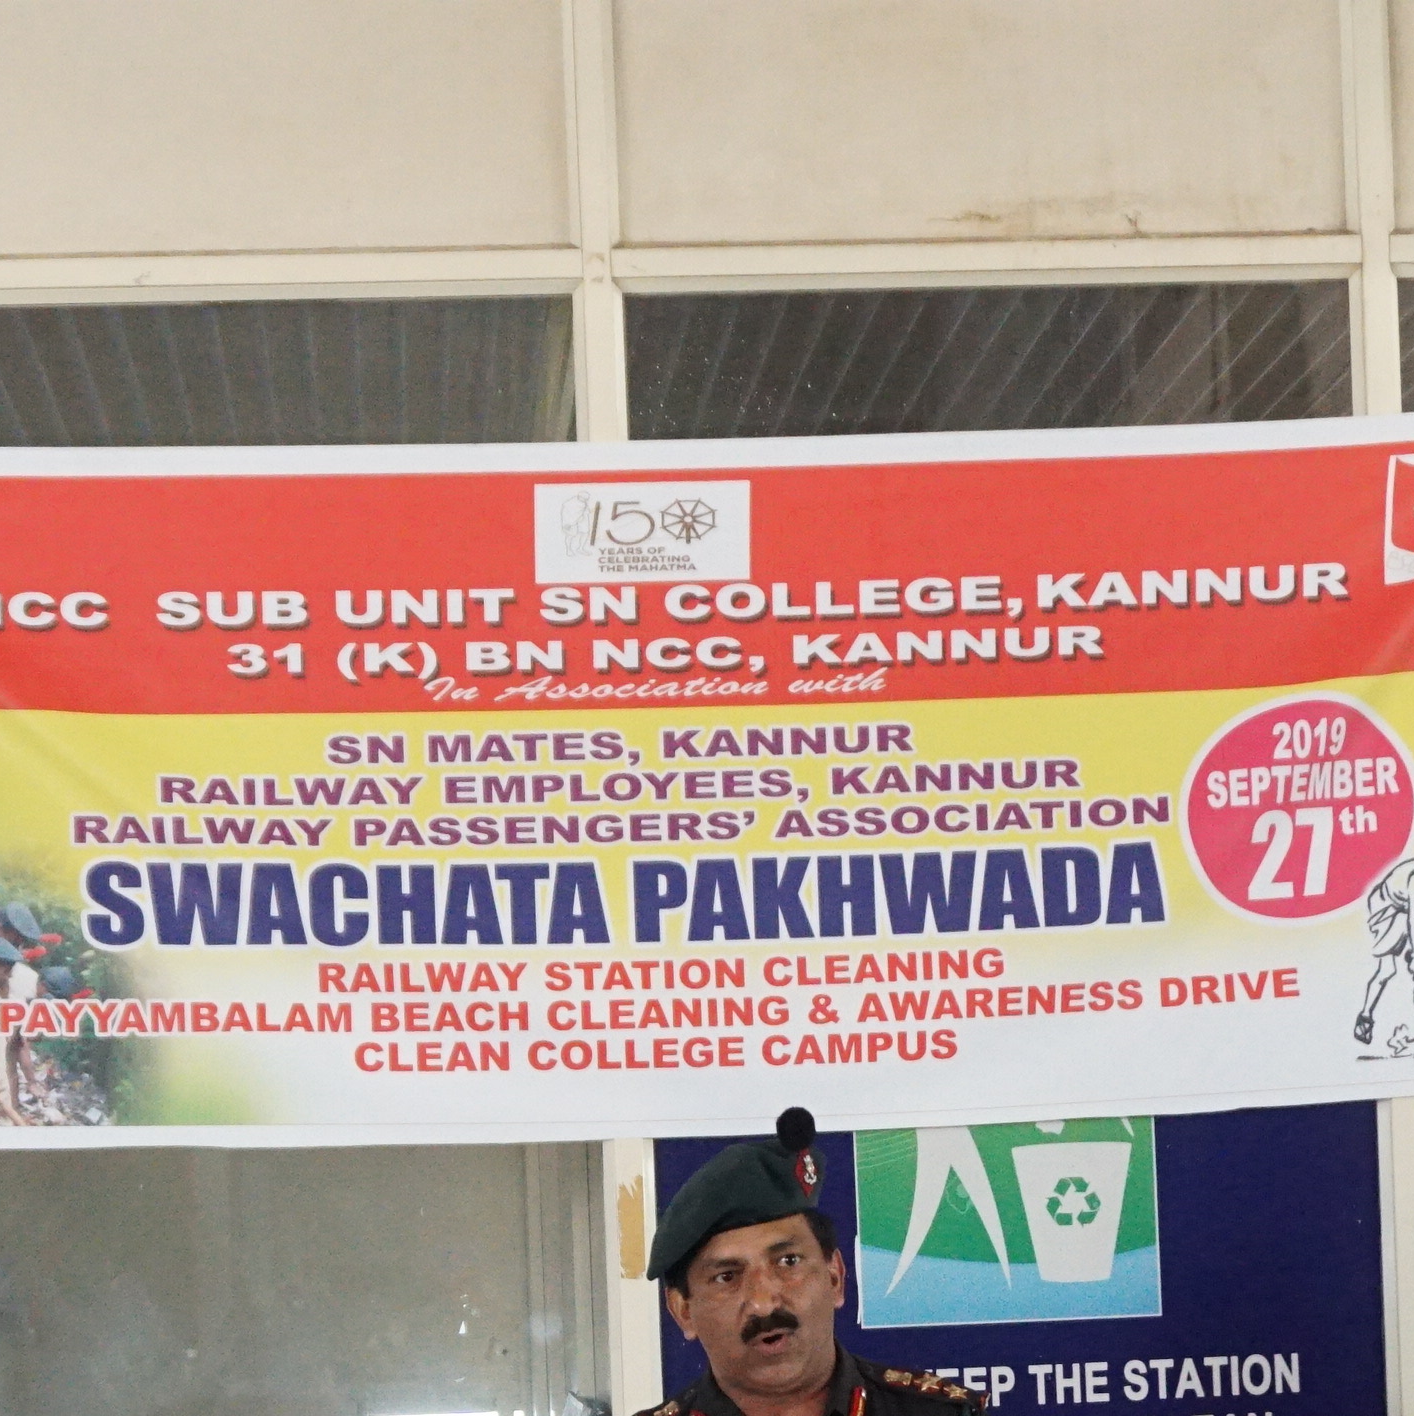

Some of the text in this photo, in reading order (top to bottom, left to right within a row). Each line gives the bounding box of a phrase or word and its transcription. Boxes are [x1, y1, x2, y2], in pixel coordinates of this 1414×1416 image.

[598, 546, 666, 555] YEARS OF
[598, 555, 691, 564] CELEBRATING
[599, 563, 697, 573] THE MAHATMA
[156, 590, 308, 628] SUB
[335, 587, 515, 626] UNIT
[539, 585, 638, 623] SN
[227, 625, 1105, 681] 31 (K) BN NCC, KANNUR
[423, 667, 888, 702] In Association with
[327, 724, 913, 766] SN MATES, KANNUR
[1272, 716, 1348, 760] 2019
[159, 759, 1080, 806] RAILWAY EMPLOYEES, KANNUR
[1206, 756, 1400, 809] SEPTEMBER
[73, 815, 333, 846] RAILWAY
[774, 796, 1170, 840] ASSOCIATION
[86, 841, 1166, 947] SWACHATA PAKHWADA
[318, 947, 1005, 994] RAILWAY STATION CLEANING
[371, 1000, 529, 1033] BEACH
[547, 994, 790, 1031] CLEANING
[808, 993, 840, 1025] &
[857, 978, 1144, 1023] AWARENESS
[1159, 967, 1300, 1008] DRIVE
[354, 1028, 958, 1073] CLEAN COLLEGE CAMPUS
[1028, 1352, 1301, 1405] THE STATION
